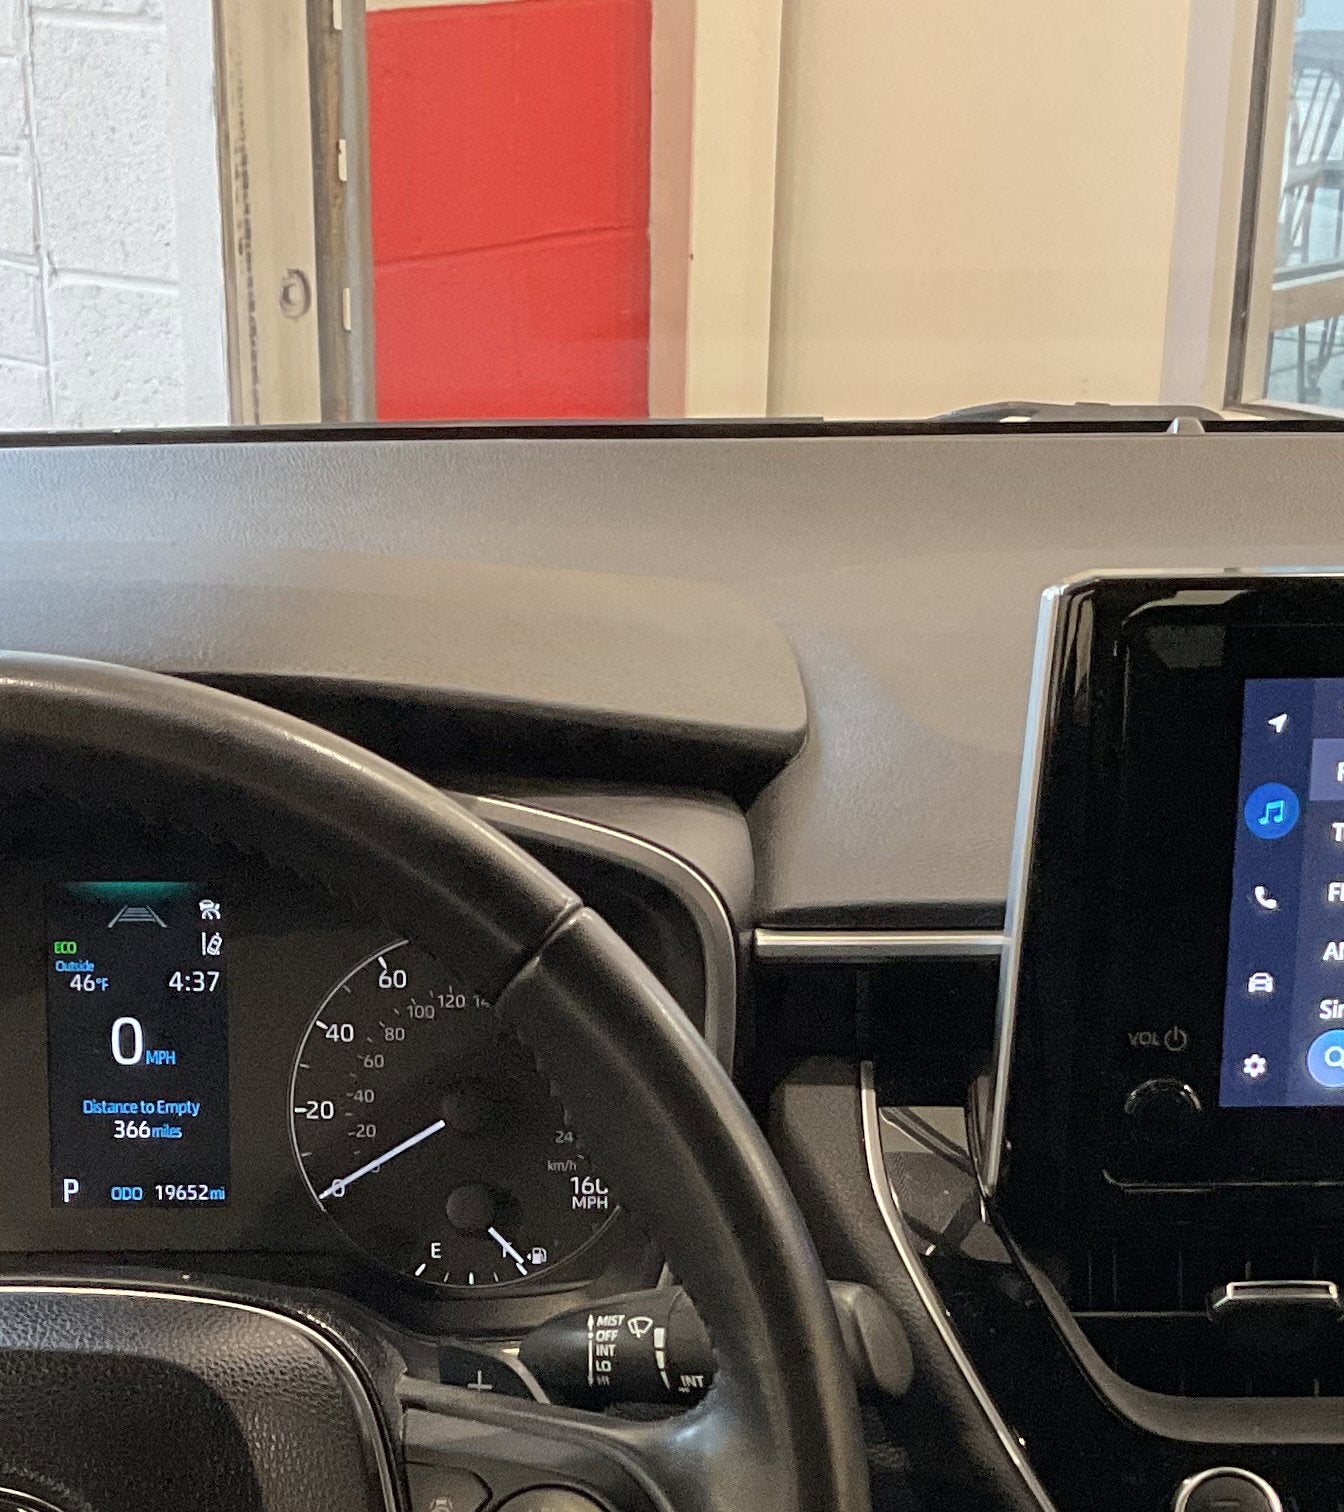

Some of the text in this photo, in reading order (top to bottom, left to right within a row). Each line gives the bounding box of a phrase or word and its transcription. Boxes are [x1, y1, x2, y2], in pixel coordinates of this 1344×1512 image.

[54, 941, 77, 954] ECO
[56, 960, 95, 972] Outside
[168, 971, 221, 992] 4:37
[378, 969, 407, 989] 60
[437, 994, 466, 1009] 120
[406, 1004, 435, 1020] 100
[111, 1016, 177, 1065] 0 MPH
[325, 1023, 355, 1043] 40
[384, 1027, 406, 1042] 80
[1127, 1031, 1160, 1046] VOL
[363, 1054, 385, 1069] 60
[353, 1089, 375, 1104] 40
[82, 1099, 201, 1117] Distance to Empty
[306, 1101, 334, 1120] 20
[113, 1120, 183, 1139] 366 miles
[355, 1123, 376, 1138] 20
[554, 1130, 574, 1144] 24
[546, 1160, 577, 1172] km/h
[63, 1178, 80, 1203] P
[111, 1186, 143, 1201] ODO
[155, 1184, 209, 1201] 19652
[331, 1178, 346, 1198] 0
[571, 1195, 609, 1209] MPH
[430, 1242, 442, 1259] E
[596, 1314, 625, 1327] MIST
[596, 1329, 619, 1342] OFF
[596, 1343, 616, 1356] INT
[596, 1360, 612, 1372] LO
[680, 1374, 704, 1388] INT
